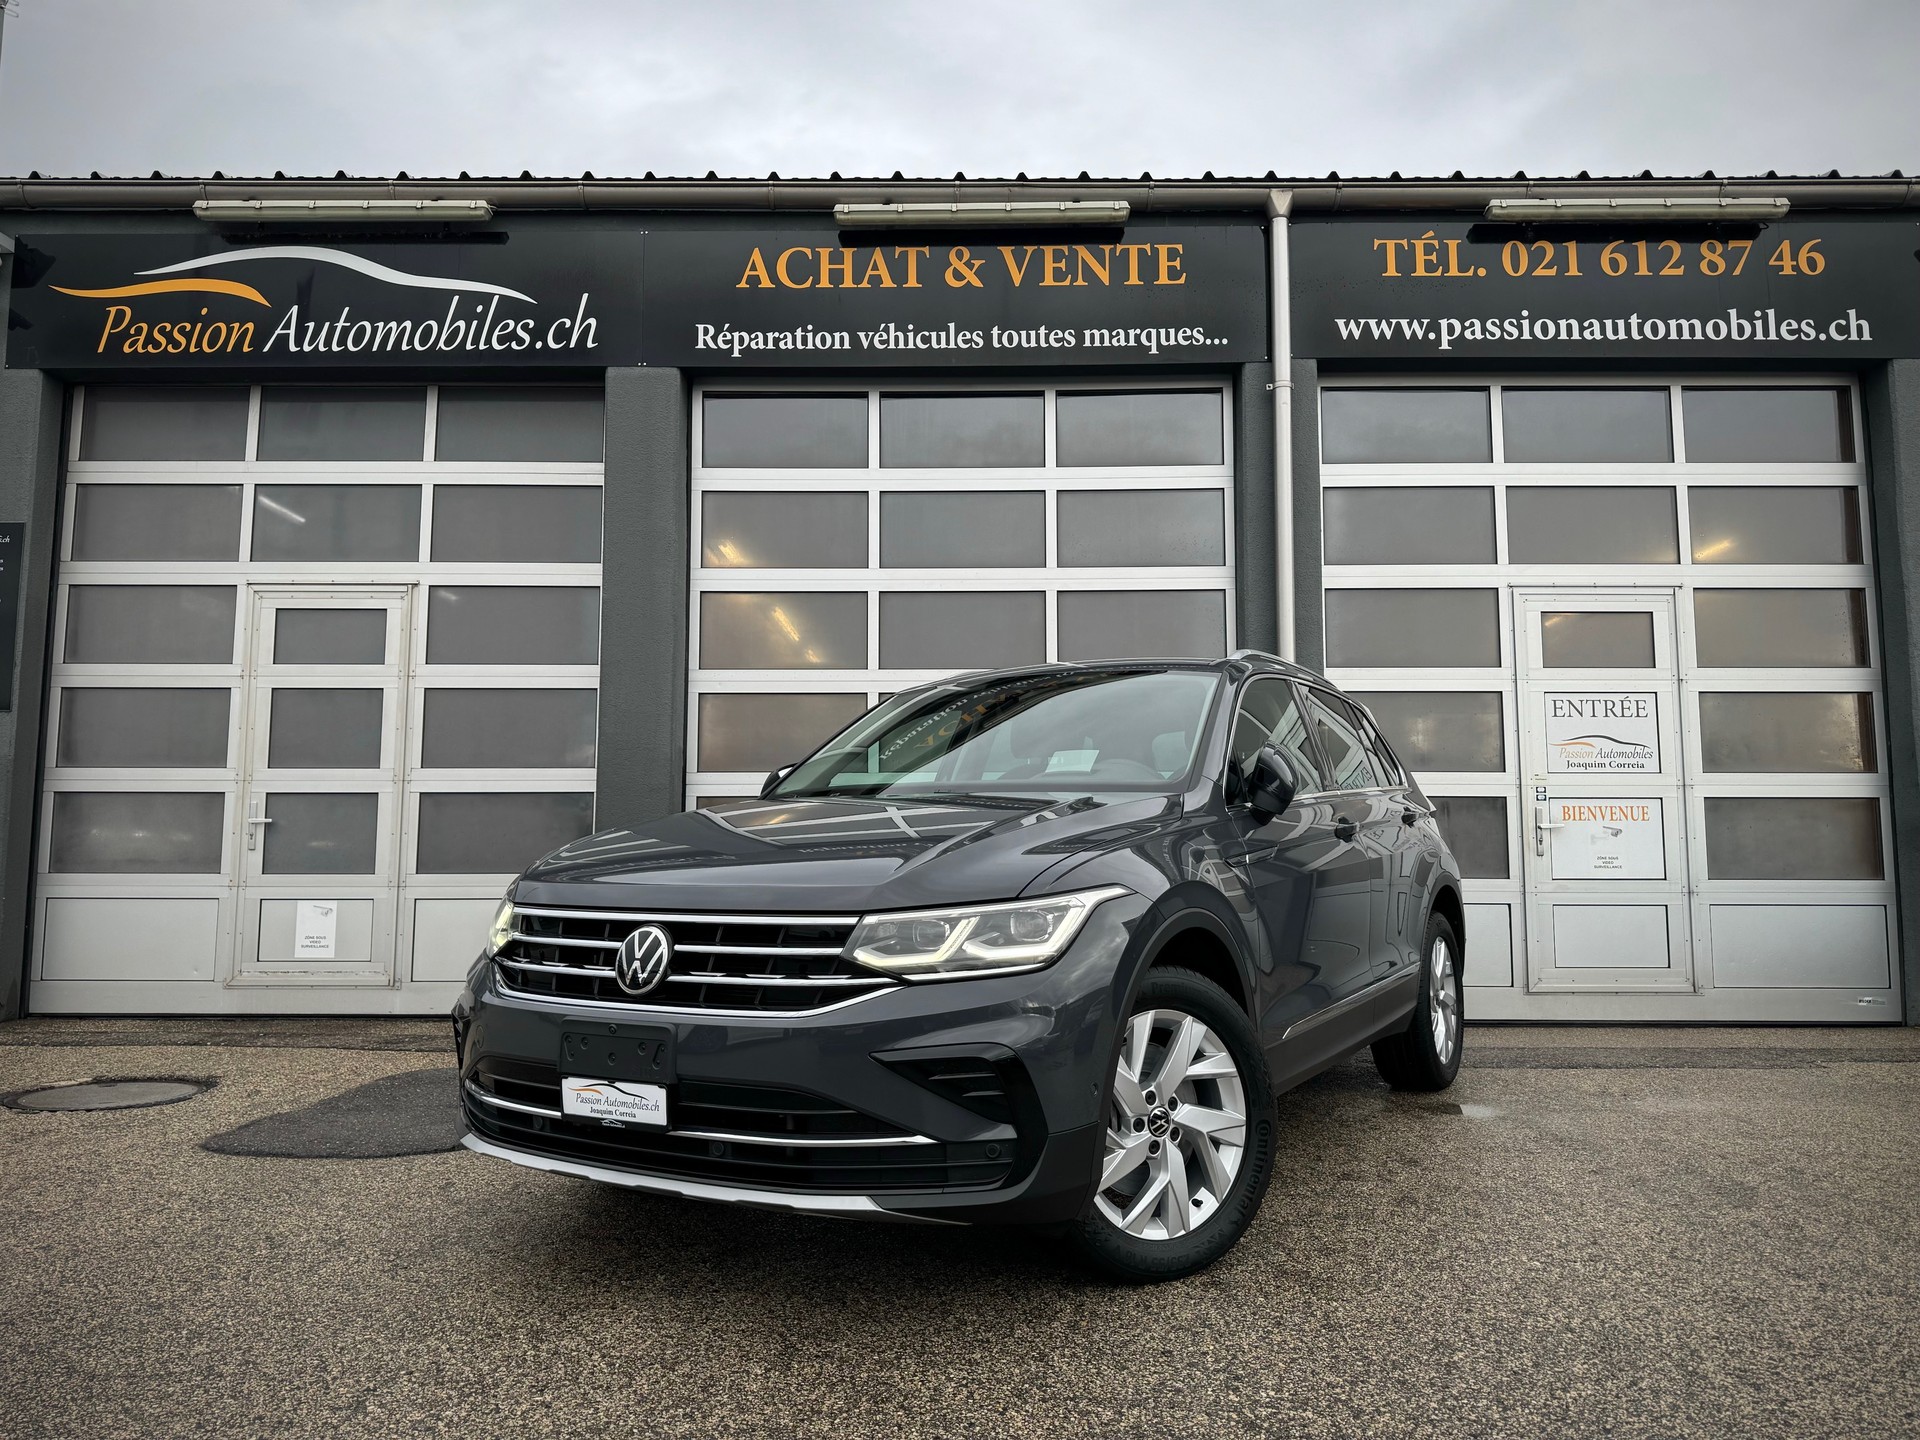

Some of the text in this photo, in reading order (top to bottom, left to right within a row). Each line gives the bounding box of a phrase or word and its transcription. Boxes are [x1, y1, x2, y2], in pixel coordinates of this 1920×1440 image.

[1373, 230, 1826, 277] TÉL. 021 612 87 46
[736, 243, 1187, 288] ACHAT & VENTE
[97, 293, 599, 354] Passion Automobiles.ch
[1334, 308, 1873, 350] www.passionautomobiles.ch
[695, 322, 1229, 358] Réparation véhicules toutes marques...
[1551, 695, 1649, 718] ENTRÉE
[1559, 745, 1654, 759] Passion Automobiles
[1566, 760, 1645, 770] Joaquim Correia
[1561, 805, 1650, 822] BIENVENUE
[576, 1093, 660, 1111] Passion Automobiles.ch
[590, 1107, 637, 1118] Joaquim Correia
